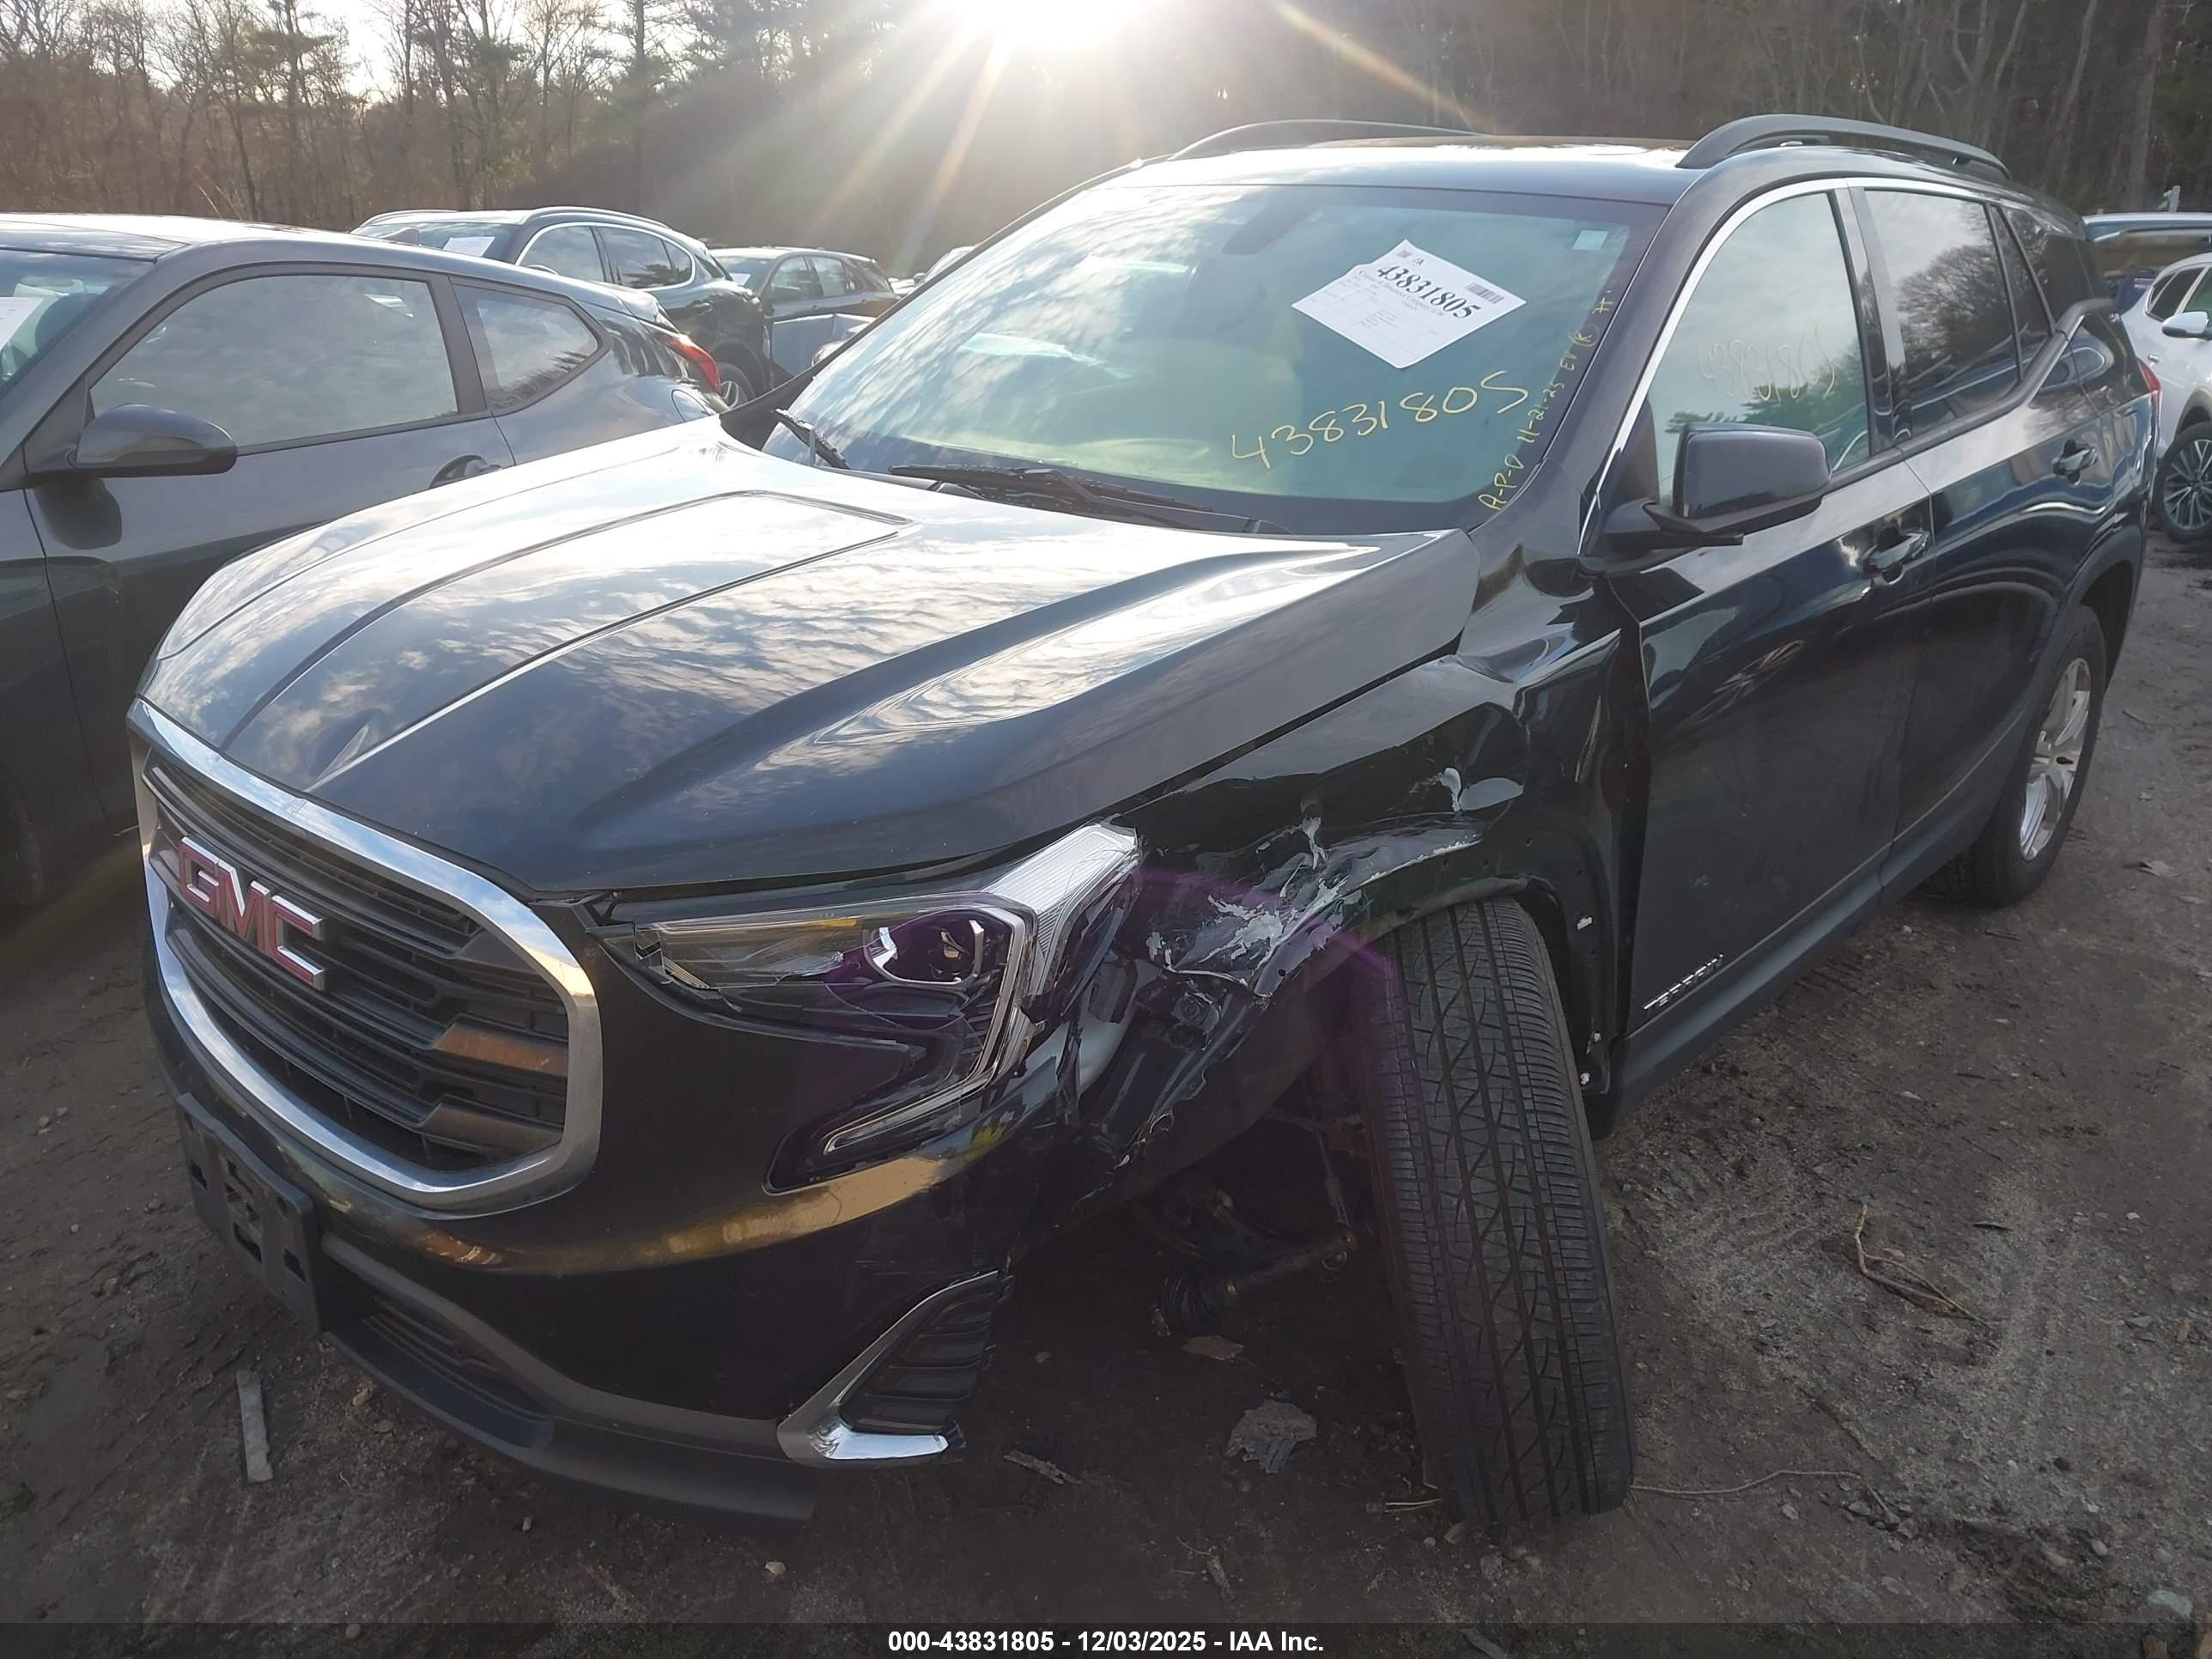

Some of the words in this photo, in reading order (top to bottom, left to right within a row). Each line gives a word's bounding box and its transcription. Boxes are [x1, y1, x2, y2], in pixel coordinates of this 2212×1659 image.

[1376, 264, 1481, 319] 43831805
[1231, 370, 1529, 470] 43831805
[178, 836, 325, 992] GMC
